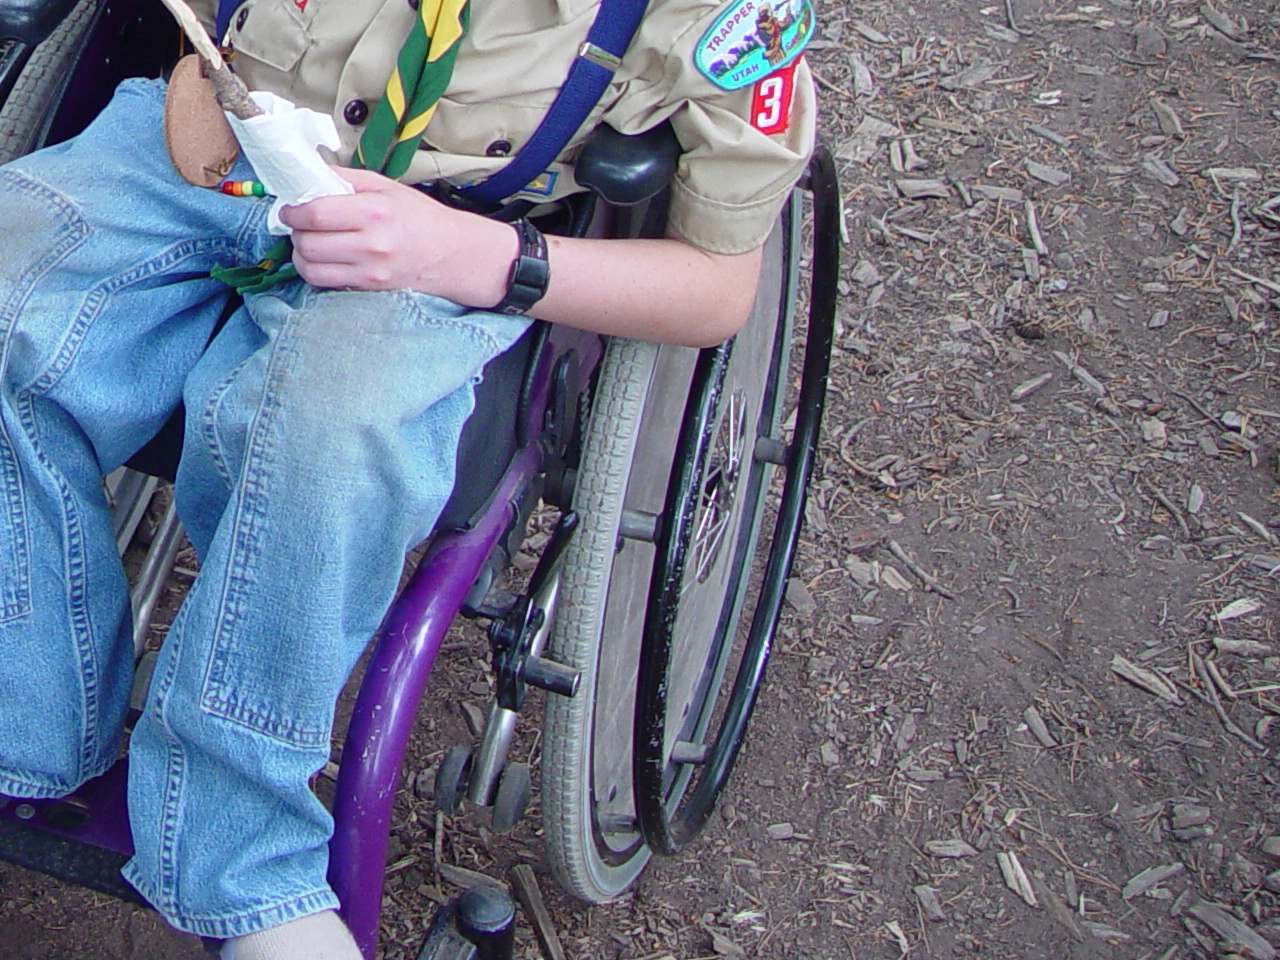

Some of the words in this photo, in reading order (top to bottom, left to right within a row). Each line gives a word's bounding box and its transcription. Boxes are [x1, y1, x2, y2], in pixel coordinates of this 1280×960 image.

[706, 1, 756, 53] TRAPPER
[731, 63, 760, 82] UTAH
[757, 76, 784, 128] 3
